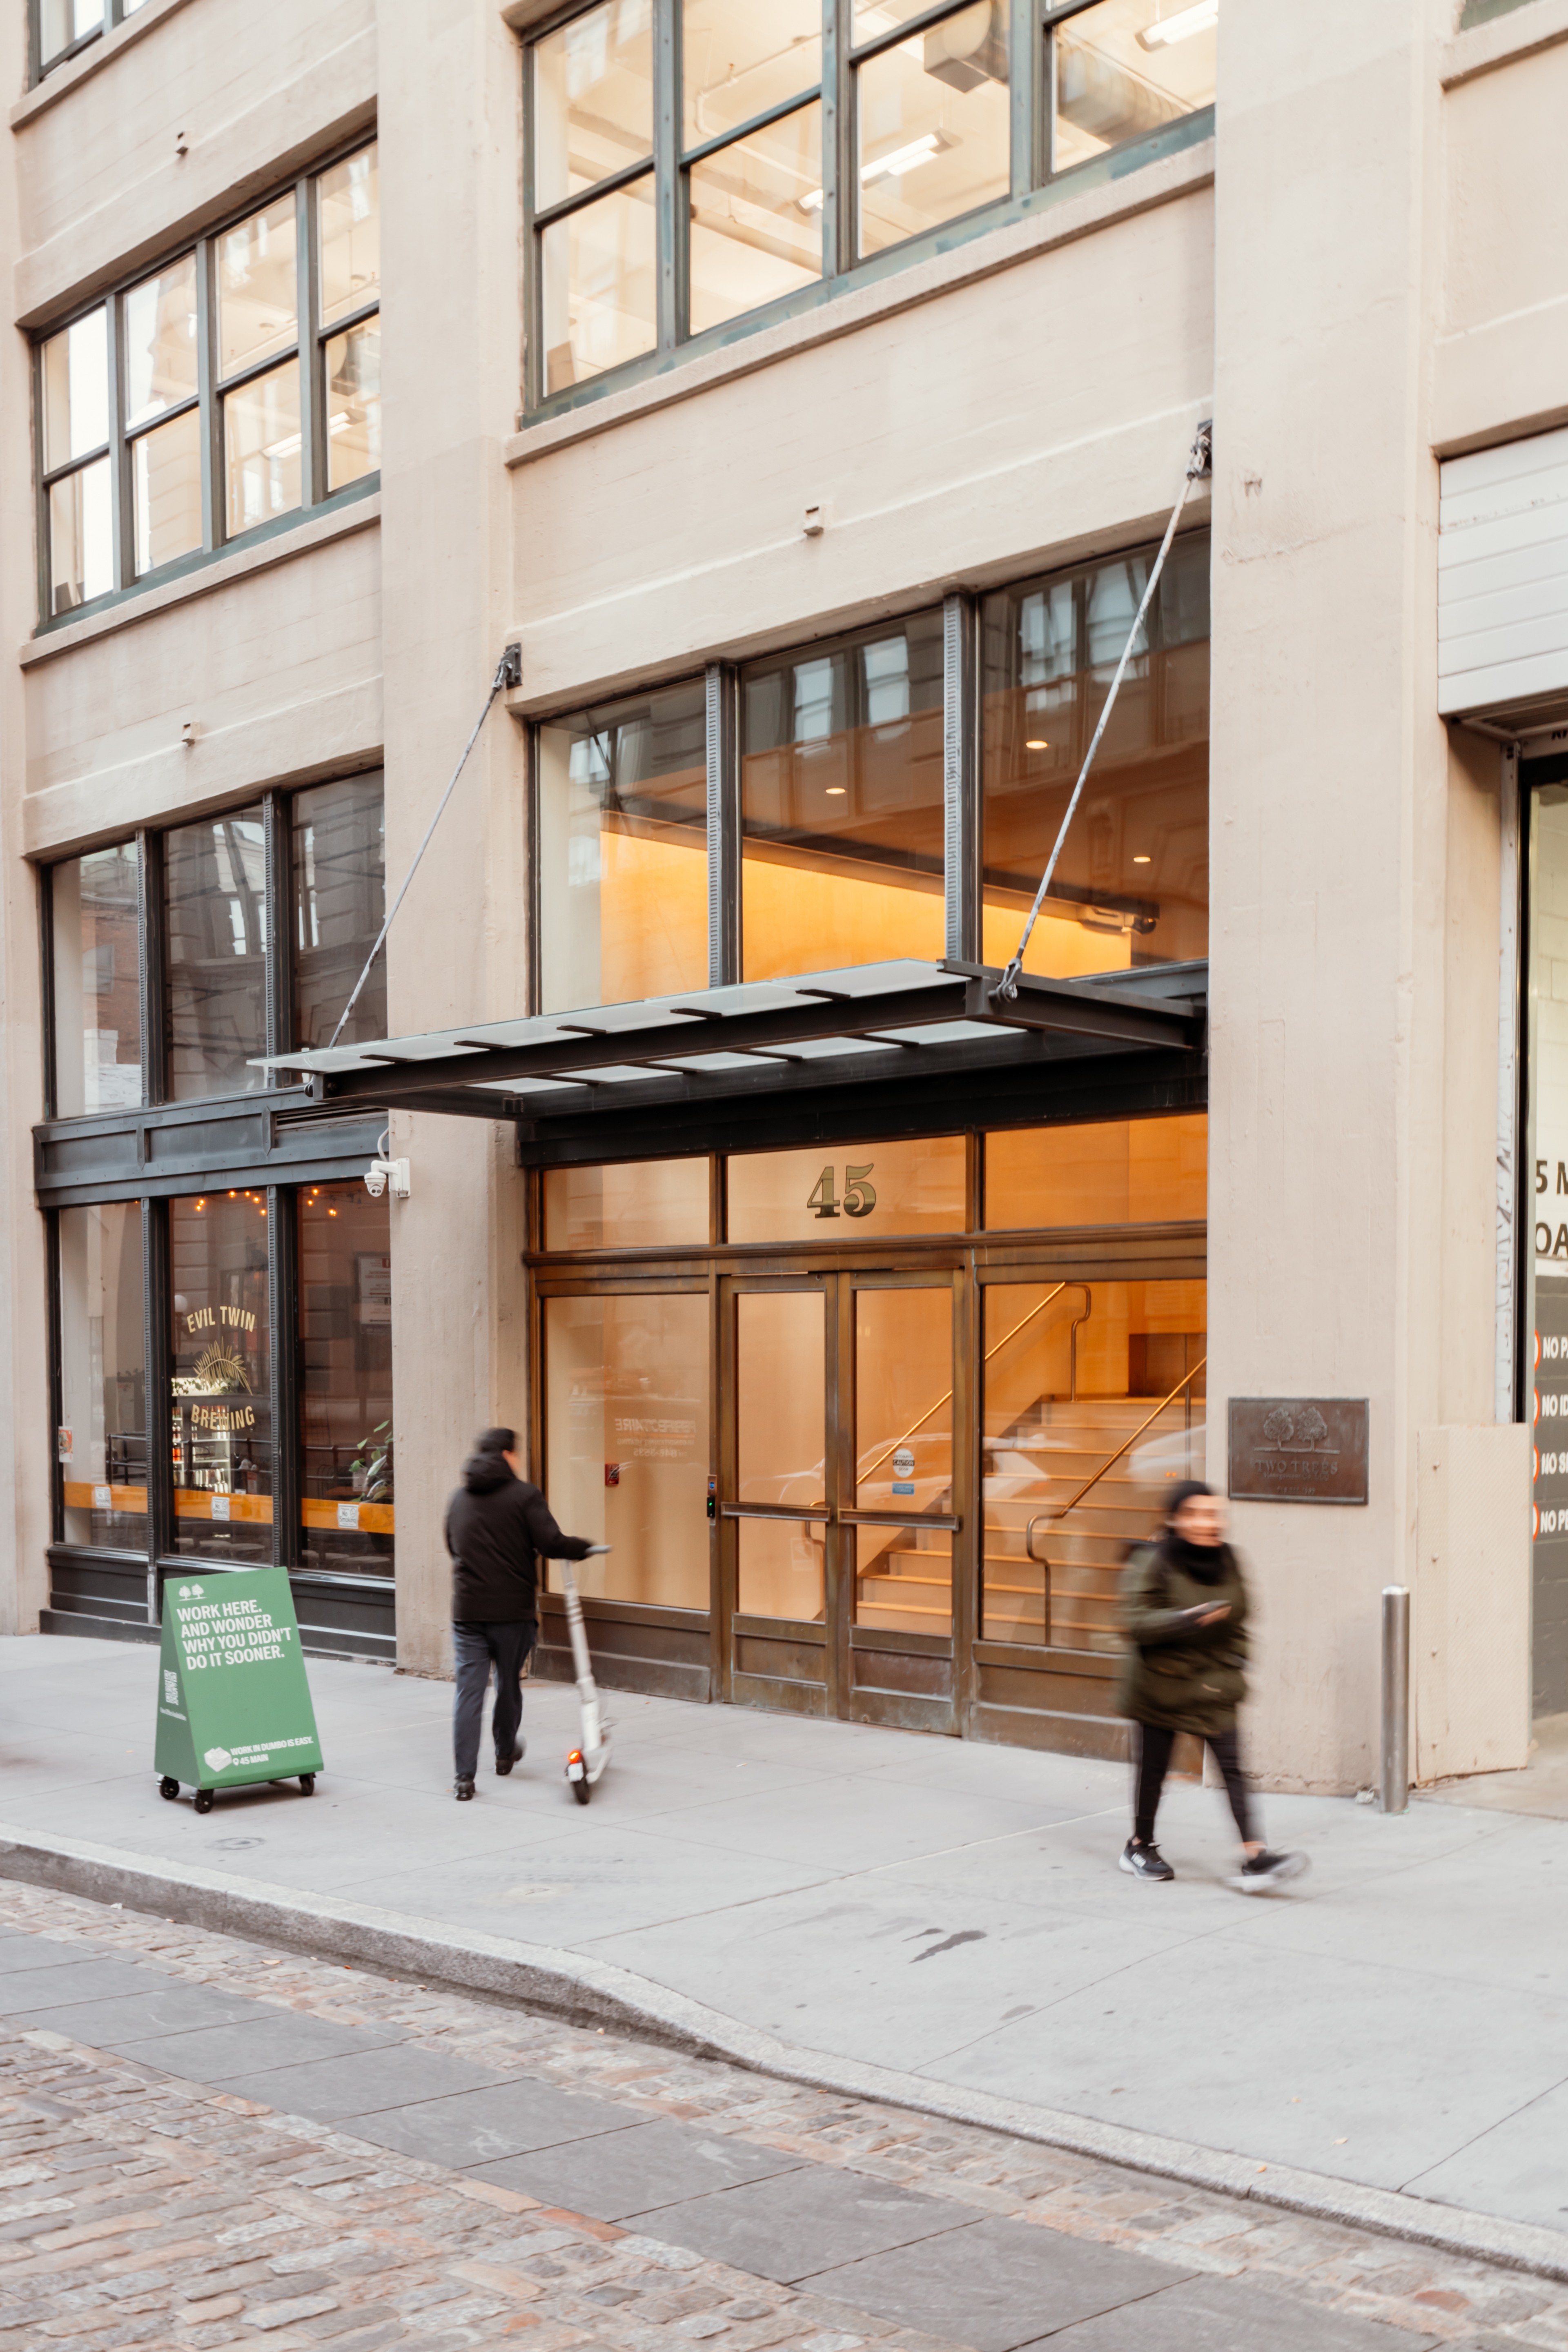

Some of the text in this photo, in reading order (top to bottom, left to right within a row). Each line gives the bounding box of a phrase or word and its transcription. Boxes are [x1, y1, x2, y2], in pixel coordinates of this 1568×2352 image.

[807, 1163, 876, 1218] 45
[187, 1306, 255, 1333] EVIL TWIN
[1543, 1337, 1559, 1359] NO
[191, 1403, 255, 1431] BREWING
[1542, 1394, 1558, 1417] NO
[1254, 1459, 1338, 1475] TWO TREES
[1541, 1452, 1557, 1475] NO
[1540, 1510, 1557, 1533] NO
[176, 1599, 262, 1622] WORK HERE.
[181, 1614, 273, 1638] AND WONDER
[183, 1627, 291, 1654] WHY YOU DIDN'T
[186, 1645, 285, 1670] DO IT SOONER.
[230, 1746, 253, 1755] WORK
[261, 1740, 287, 1751] DUMBO
[287, 1739, 295, 1747] IS
[294, 1736, 314, 1746] EASY.
[240, 1753, 269, 1765] 45 MAIN
